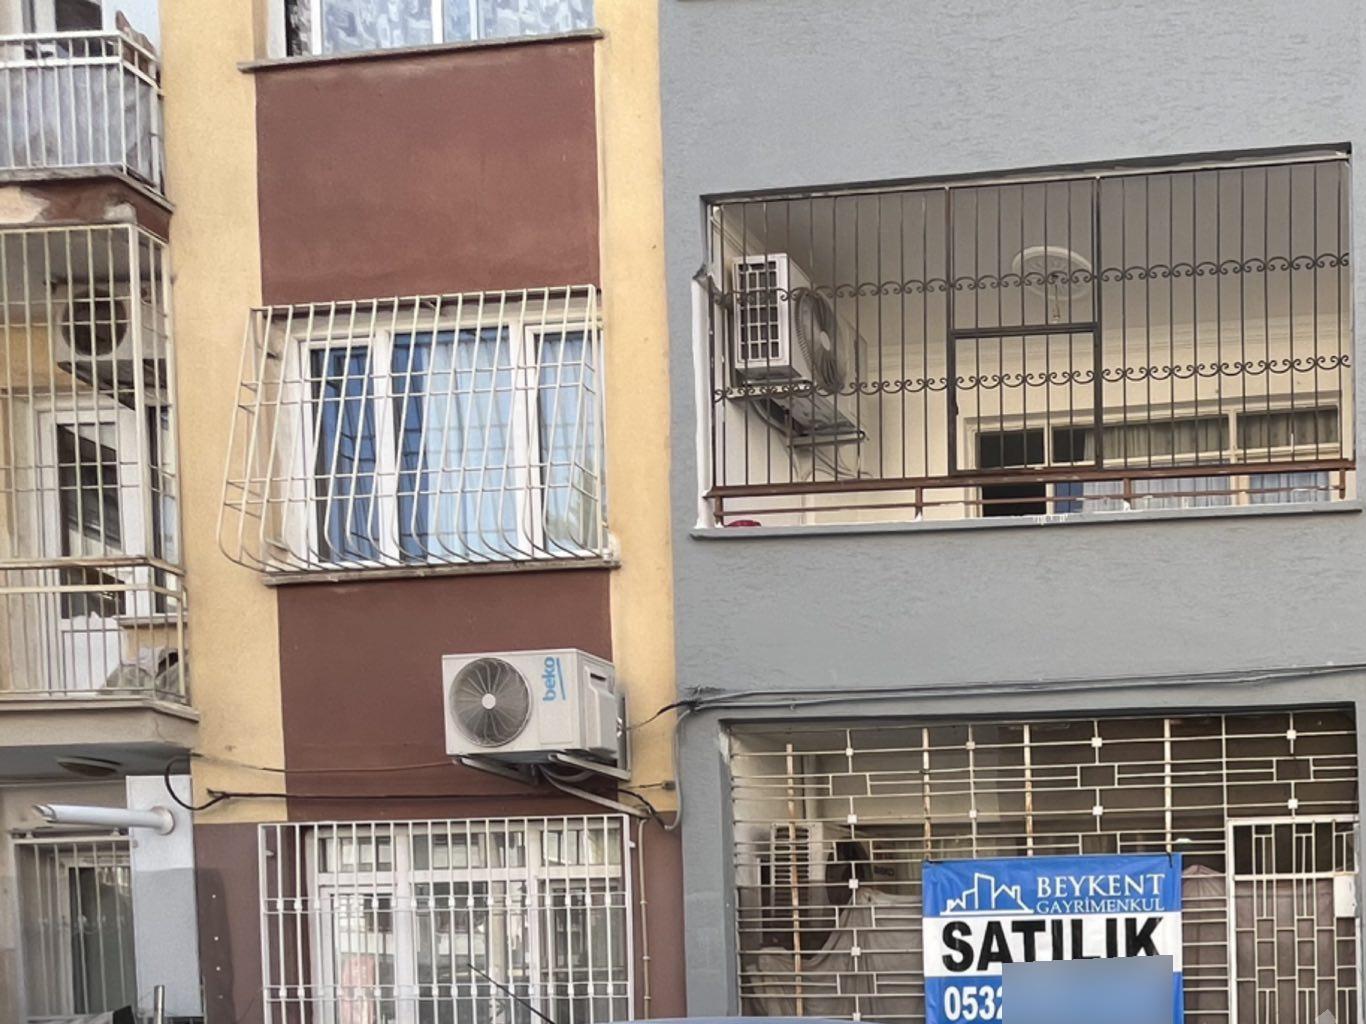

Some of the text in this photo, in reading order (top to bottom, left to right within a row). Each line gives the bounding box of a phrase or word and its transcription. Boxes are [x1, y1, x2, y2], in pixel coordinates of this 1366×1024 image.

[541, 656, 556, 702] beko
[1036, 873, 1166, 898] BEYKENT
[1035, 896, 1166, 915] GAYRİMENKUL
[941, 915, 1164, 973] SATILIK
